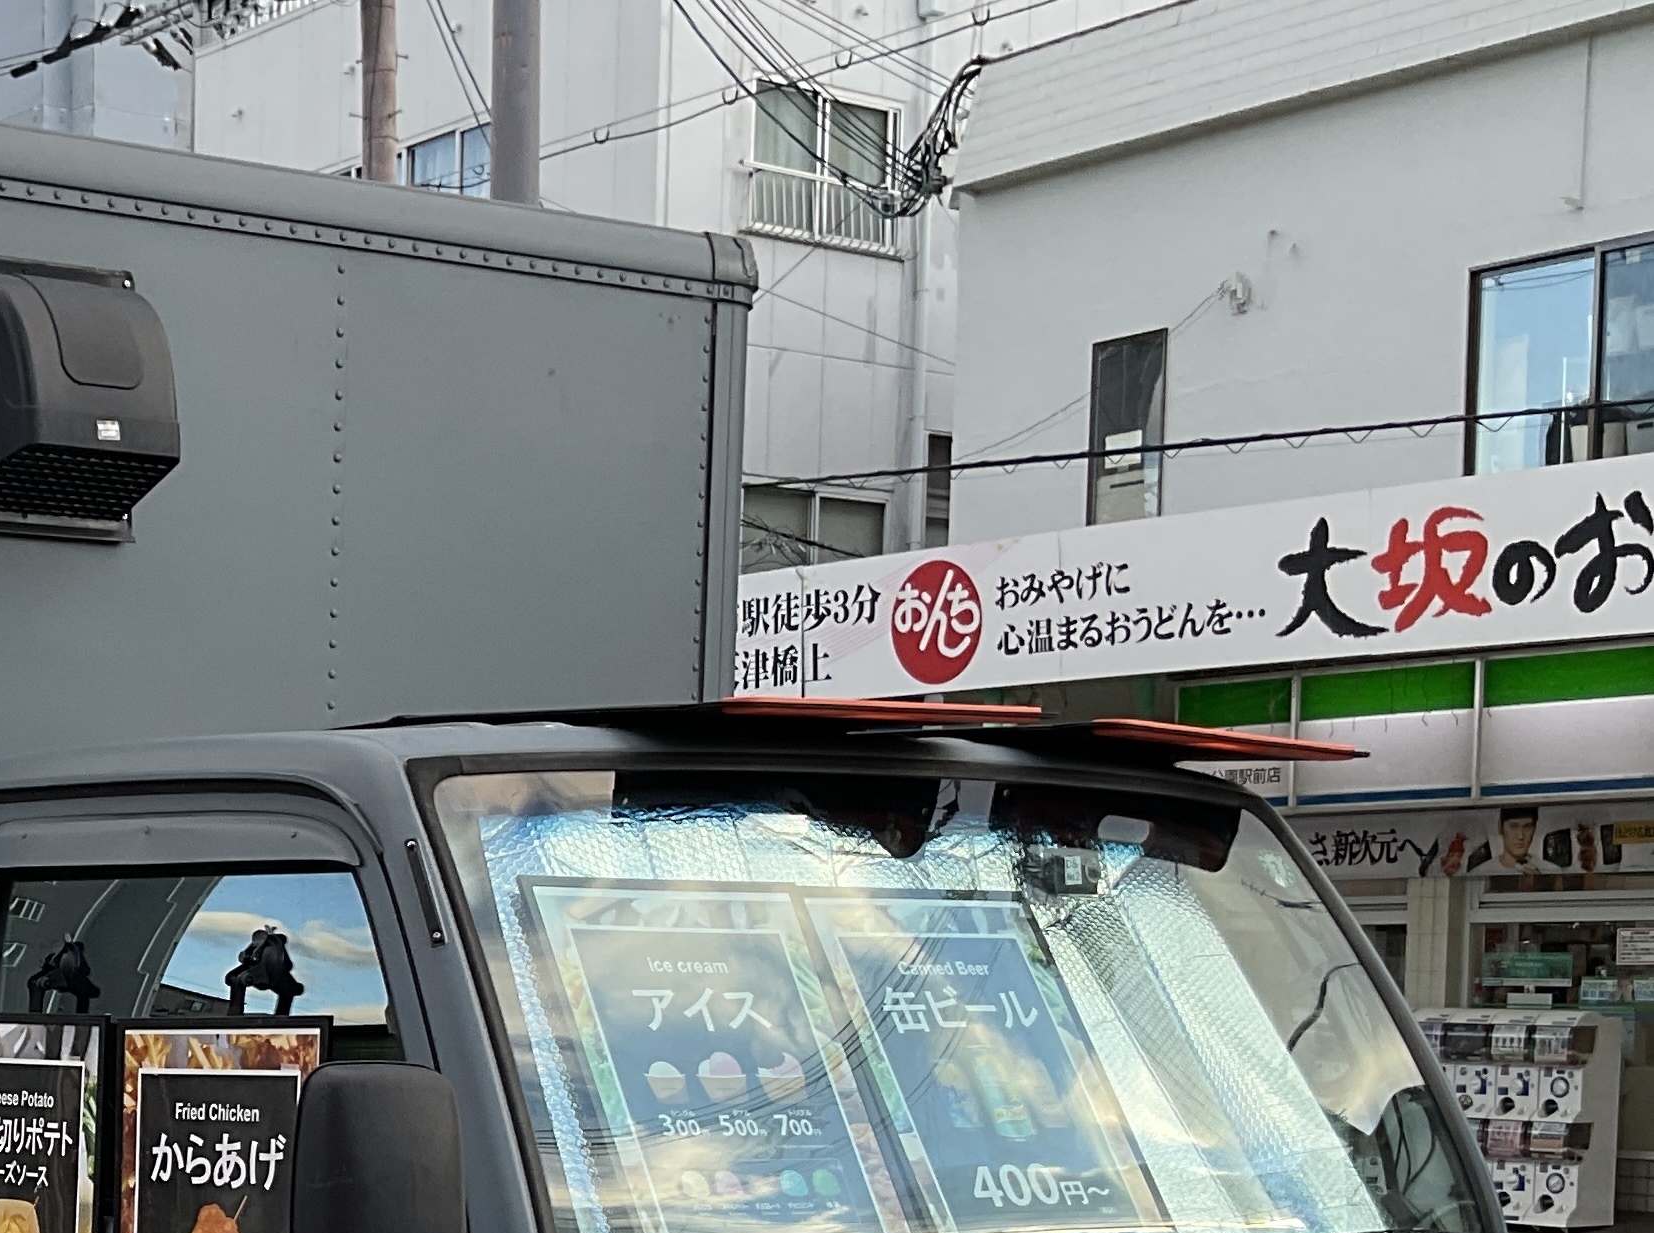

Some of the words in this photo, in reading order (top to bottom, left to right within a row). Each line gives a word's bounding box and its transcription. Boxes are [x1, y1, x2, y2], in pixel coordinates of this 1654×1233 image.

[995, 561, 1131, 611] おみやげに
[735, 582, 882, 638] 駅徒歩3分
[732, 643, 832, 692] 津橋上
[677, 959, 730, 975] cream
[897, 961, 954, 977] Canned
[955, 961, 990, 976] Beer
[631, 987, 773, 1033] アイス
[882, 985, 1039, 1034] 缶ビール
[21, 1090, 55, 1109] Potato
[175, 1102, 206, 1121] Fried
[209, 1103, 260, 1122] Chicken
[150, 1132, 287, 1192] からあげ
